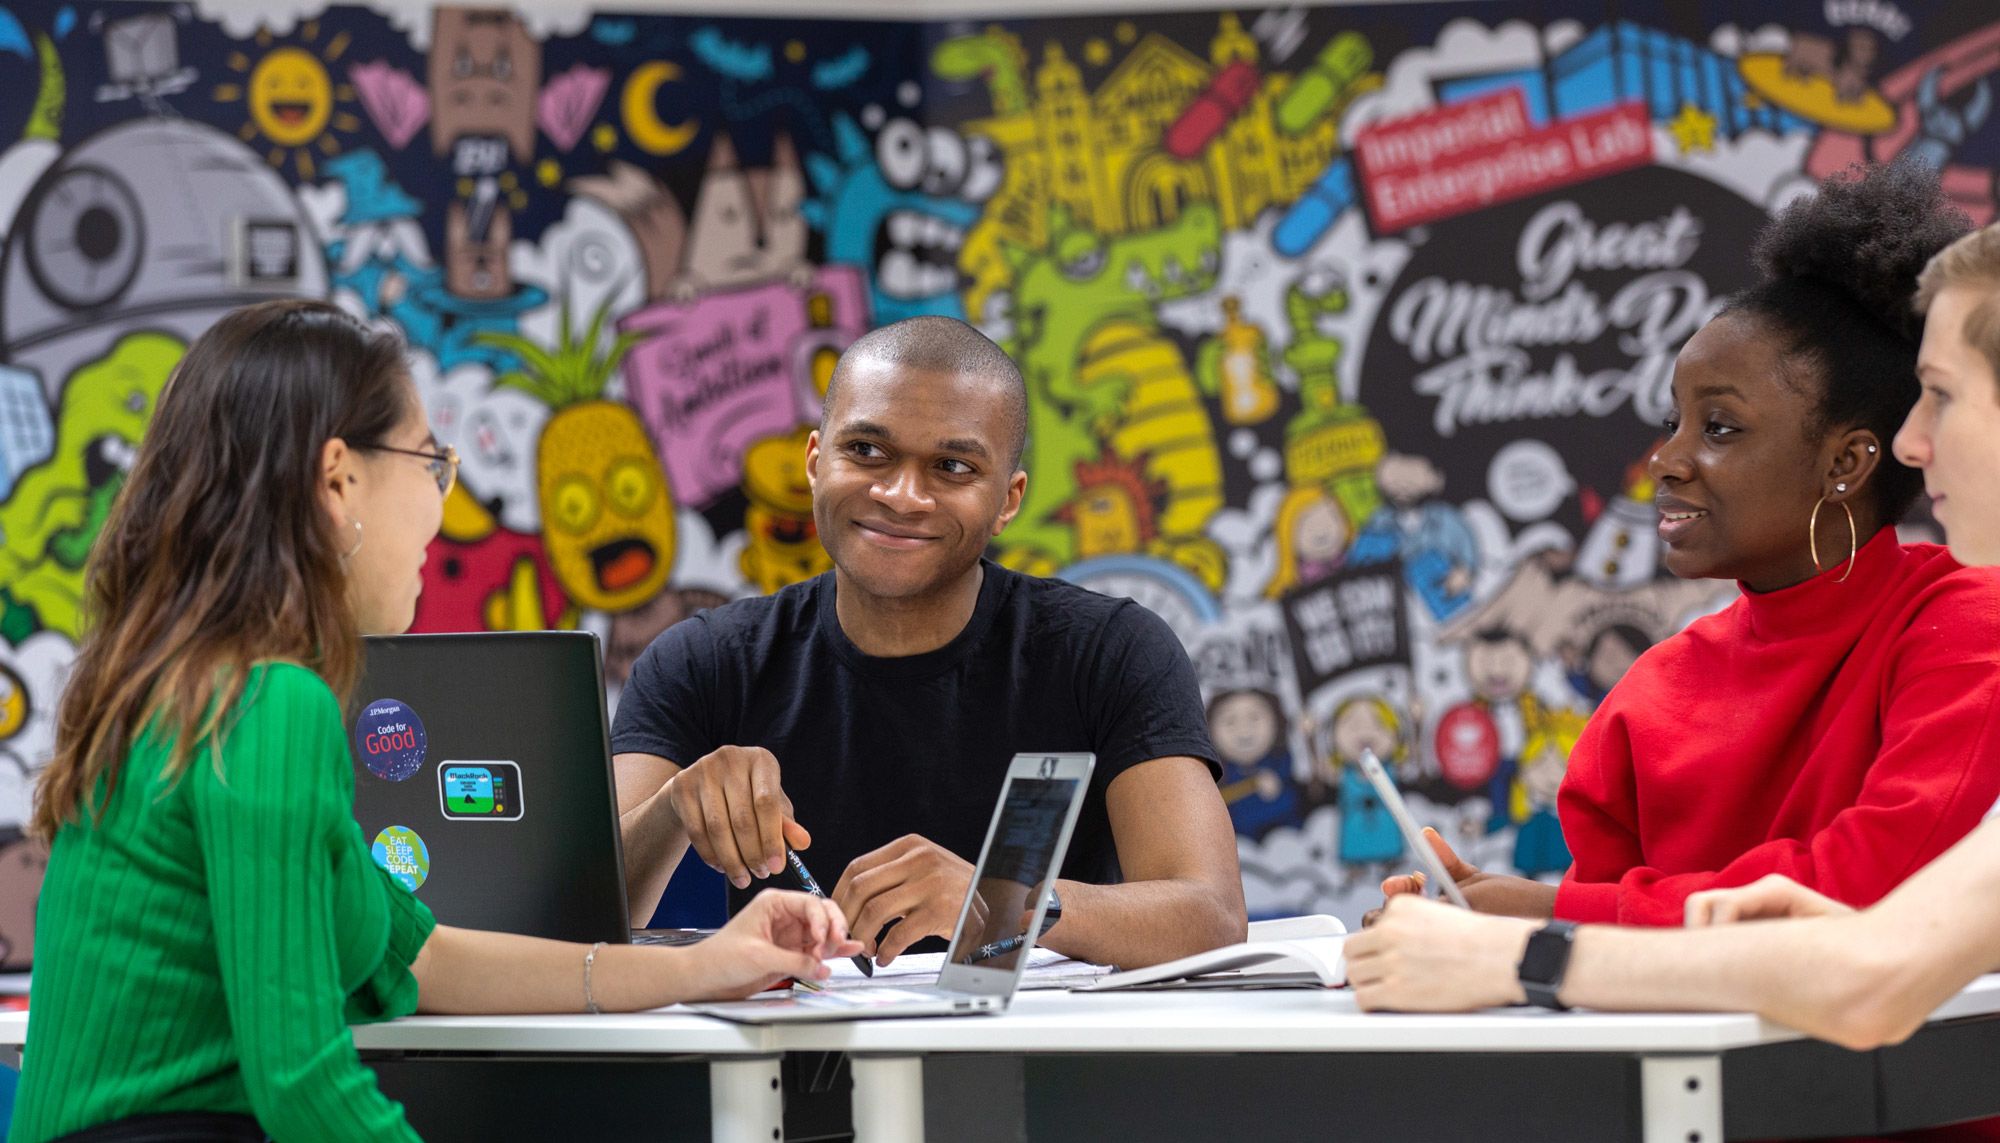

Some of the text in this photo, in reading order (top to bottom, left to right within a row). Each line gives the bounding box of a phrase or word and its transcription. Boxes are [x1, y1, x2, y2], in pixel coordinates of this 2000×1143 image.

[1361, 98, 1524, 172] Imperial
[1375, 113, 1645, 219] Enterprise Lab
[1518, 202, 1699, 300] Great
[1391, 277, 1604, 361] Minds
[1415, 347, 1583, 437] Think
[1298, 578, 1393, 630] WE CAN
[1307, 632, 1352, 675] DO
[365, 725, 416, 755] Good
[377, 722, 407, 734] Code for
[386, 845, 413, 855] SLEEP
[386, 855, 414, 865] CODE
[390, 836, 407, 845] EAT
